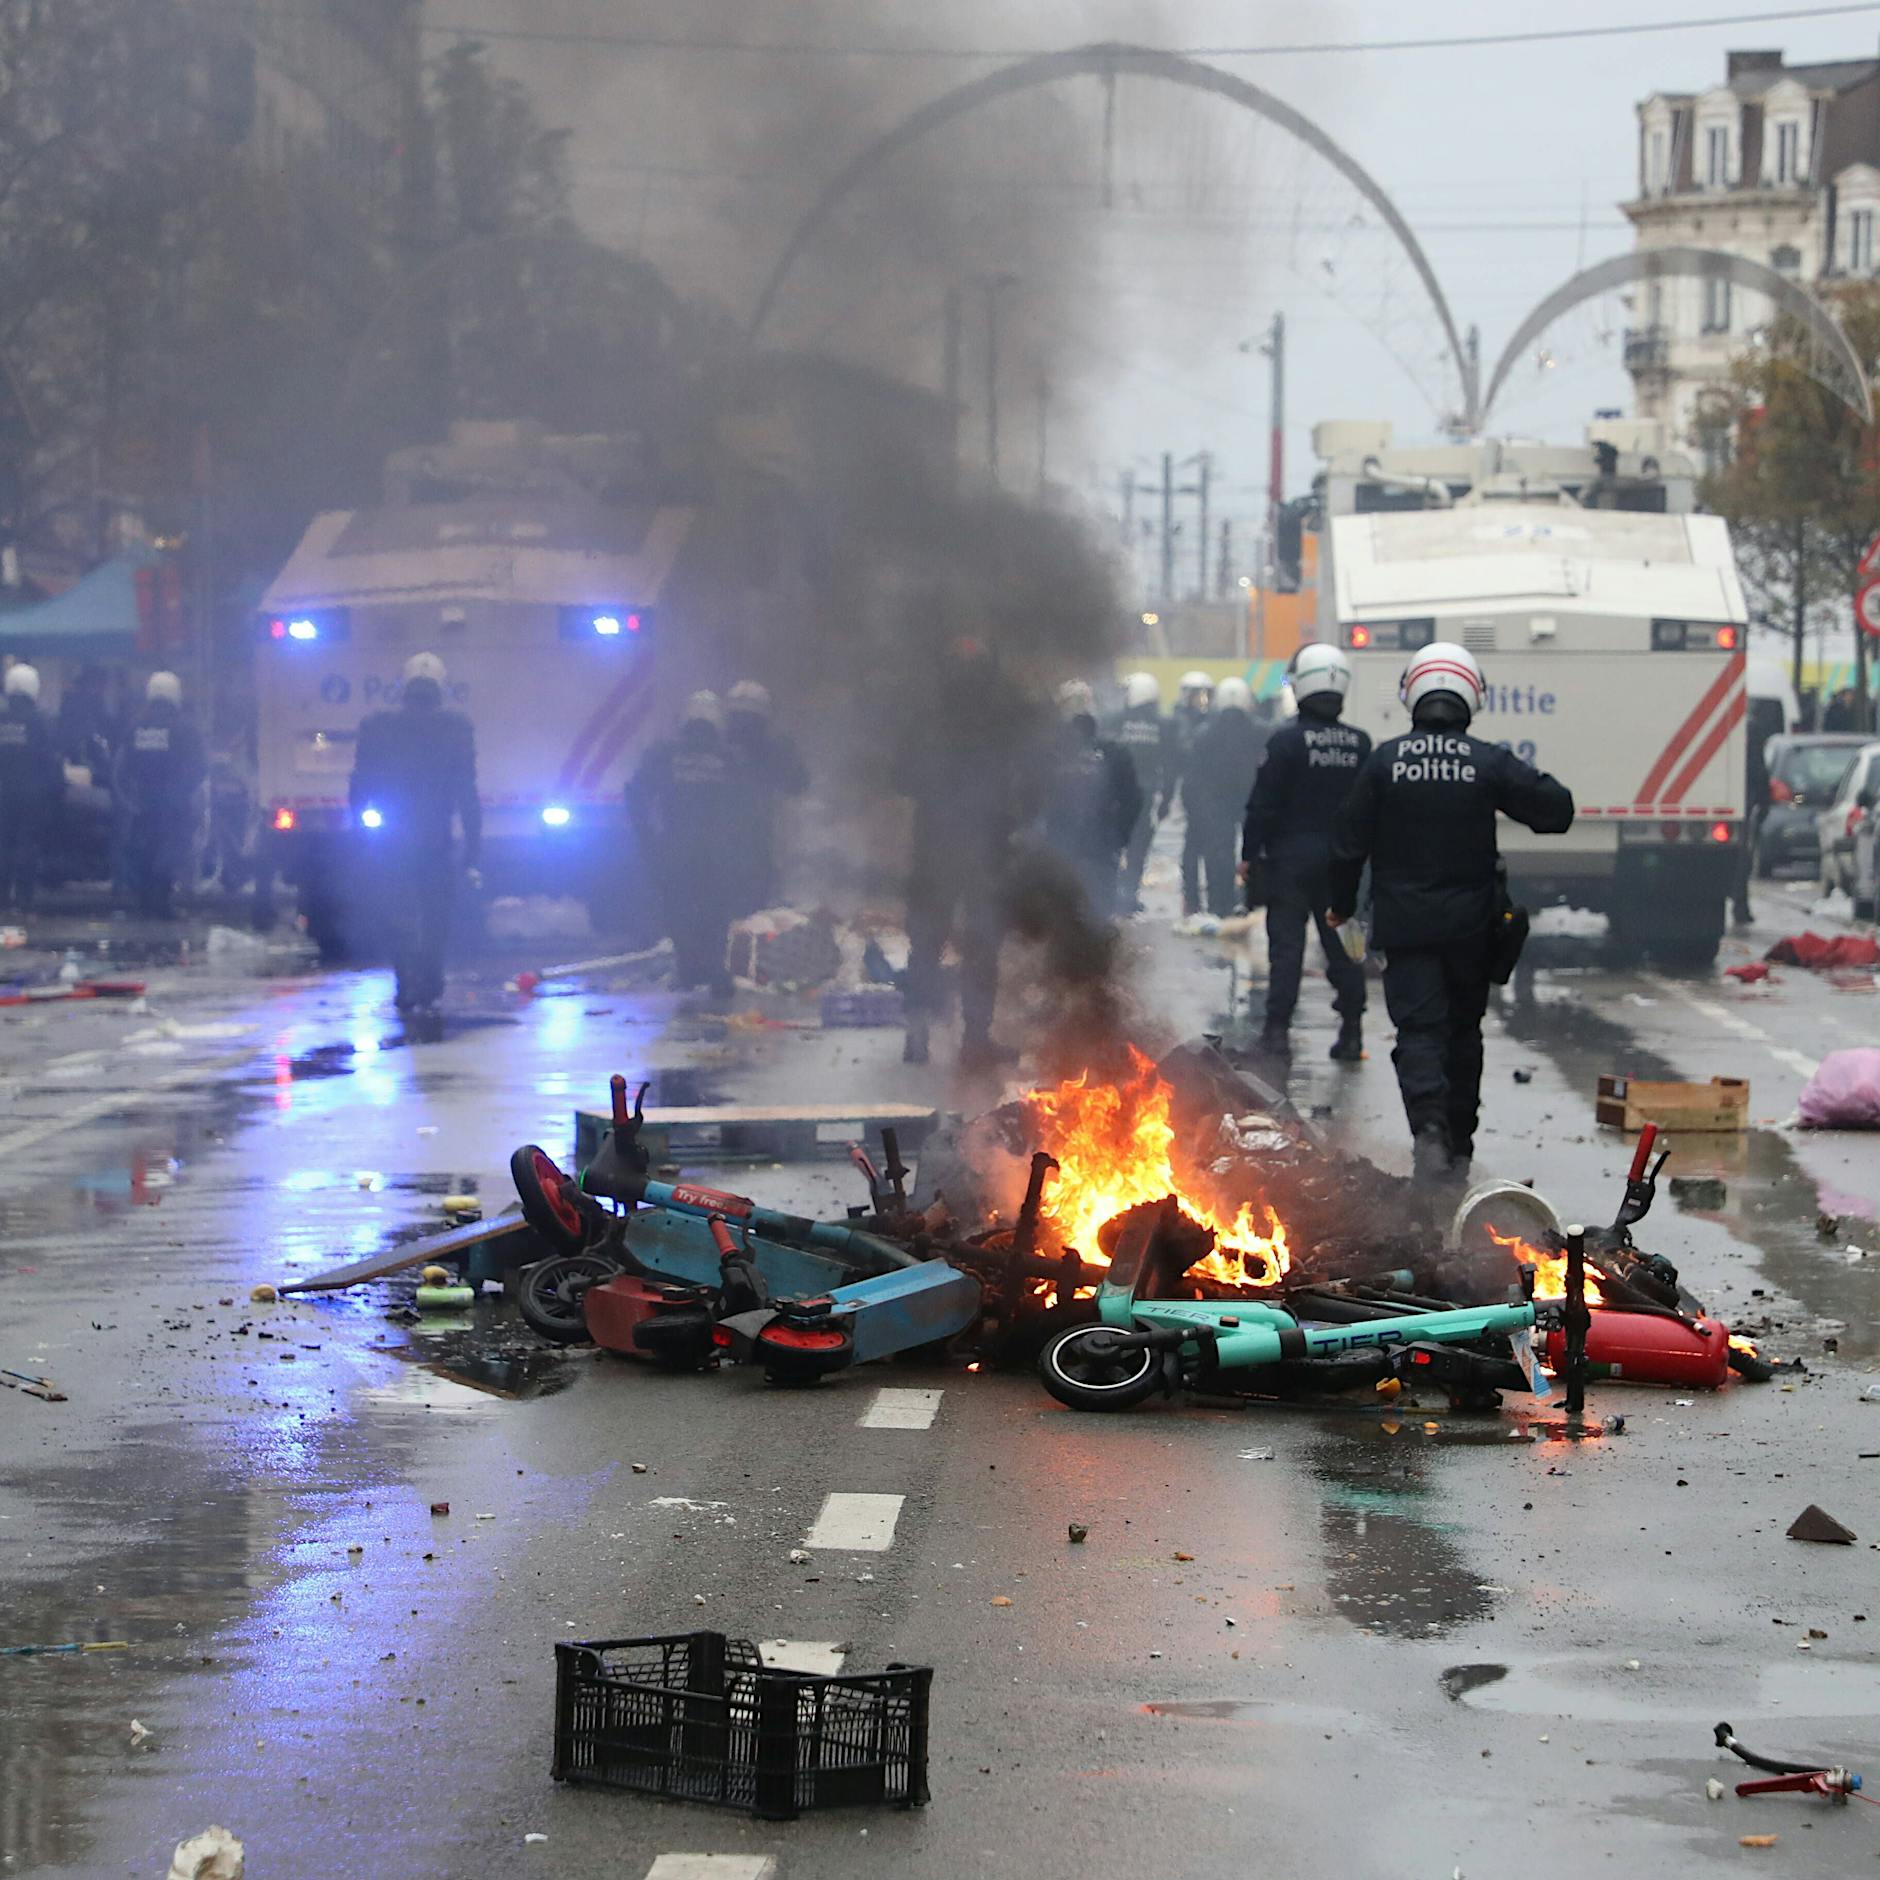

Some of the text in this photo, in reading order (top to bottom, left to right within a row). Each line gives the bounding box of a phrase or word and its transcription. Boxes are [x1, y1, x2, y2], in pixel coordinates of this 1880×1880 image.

[1487, 684, 1556, 715] litie
[1303, 727, 1359, 748] Politie
[1397, 734, 1471, 757] Police
[1308, 749, 1359, 768] Police
[1392, 757, 1476, 783] Politie
[677, 1188, 697, 1204] Try
[1146, 1306, 1211, 1321] TIER
[1312, 1330, 1402, 1350] TIER
